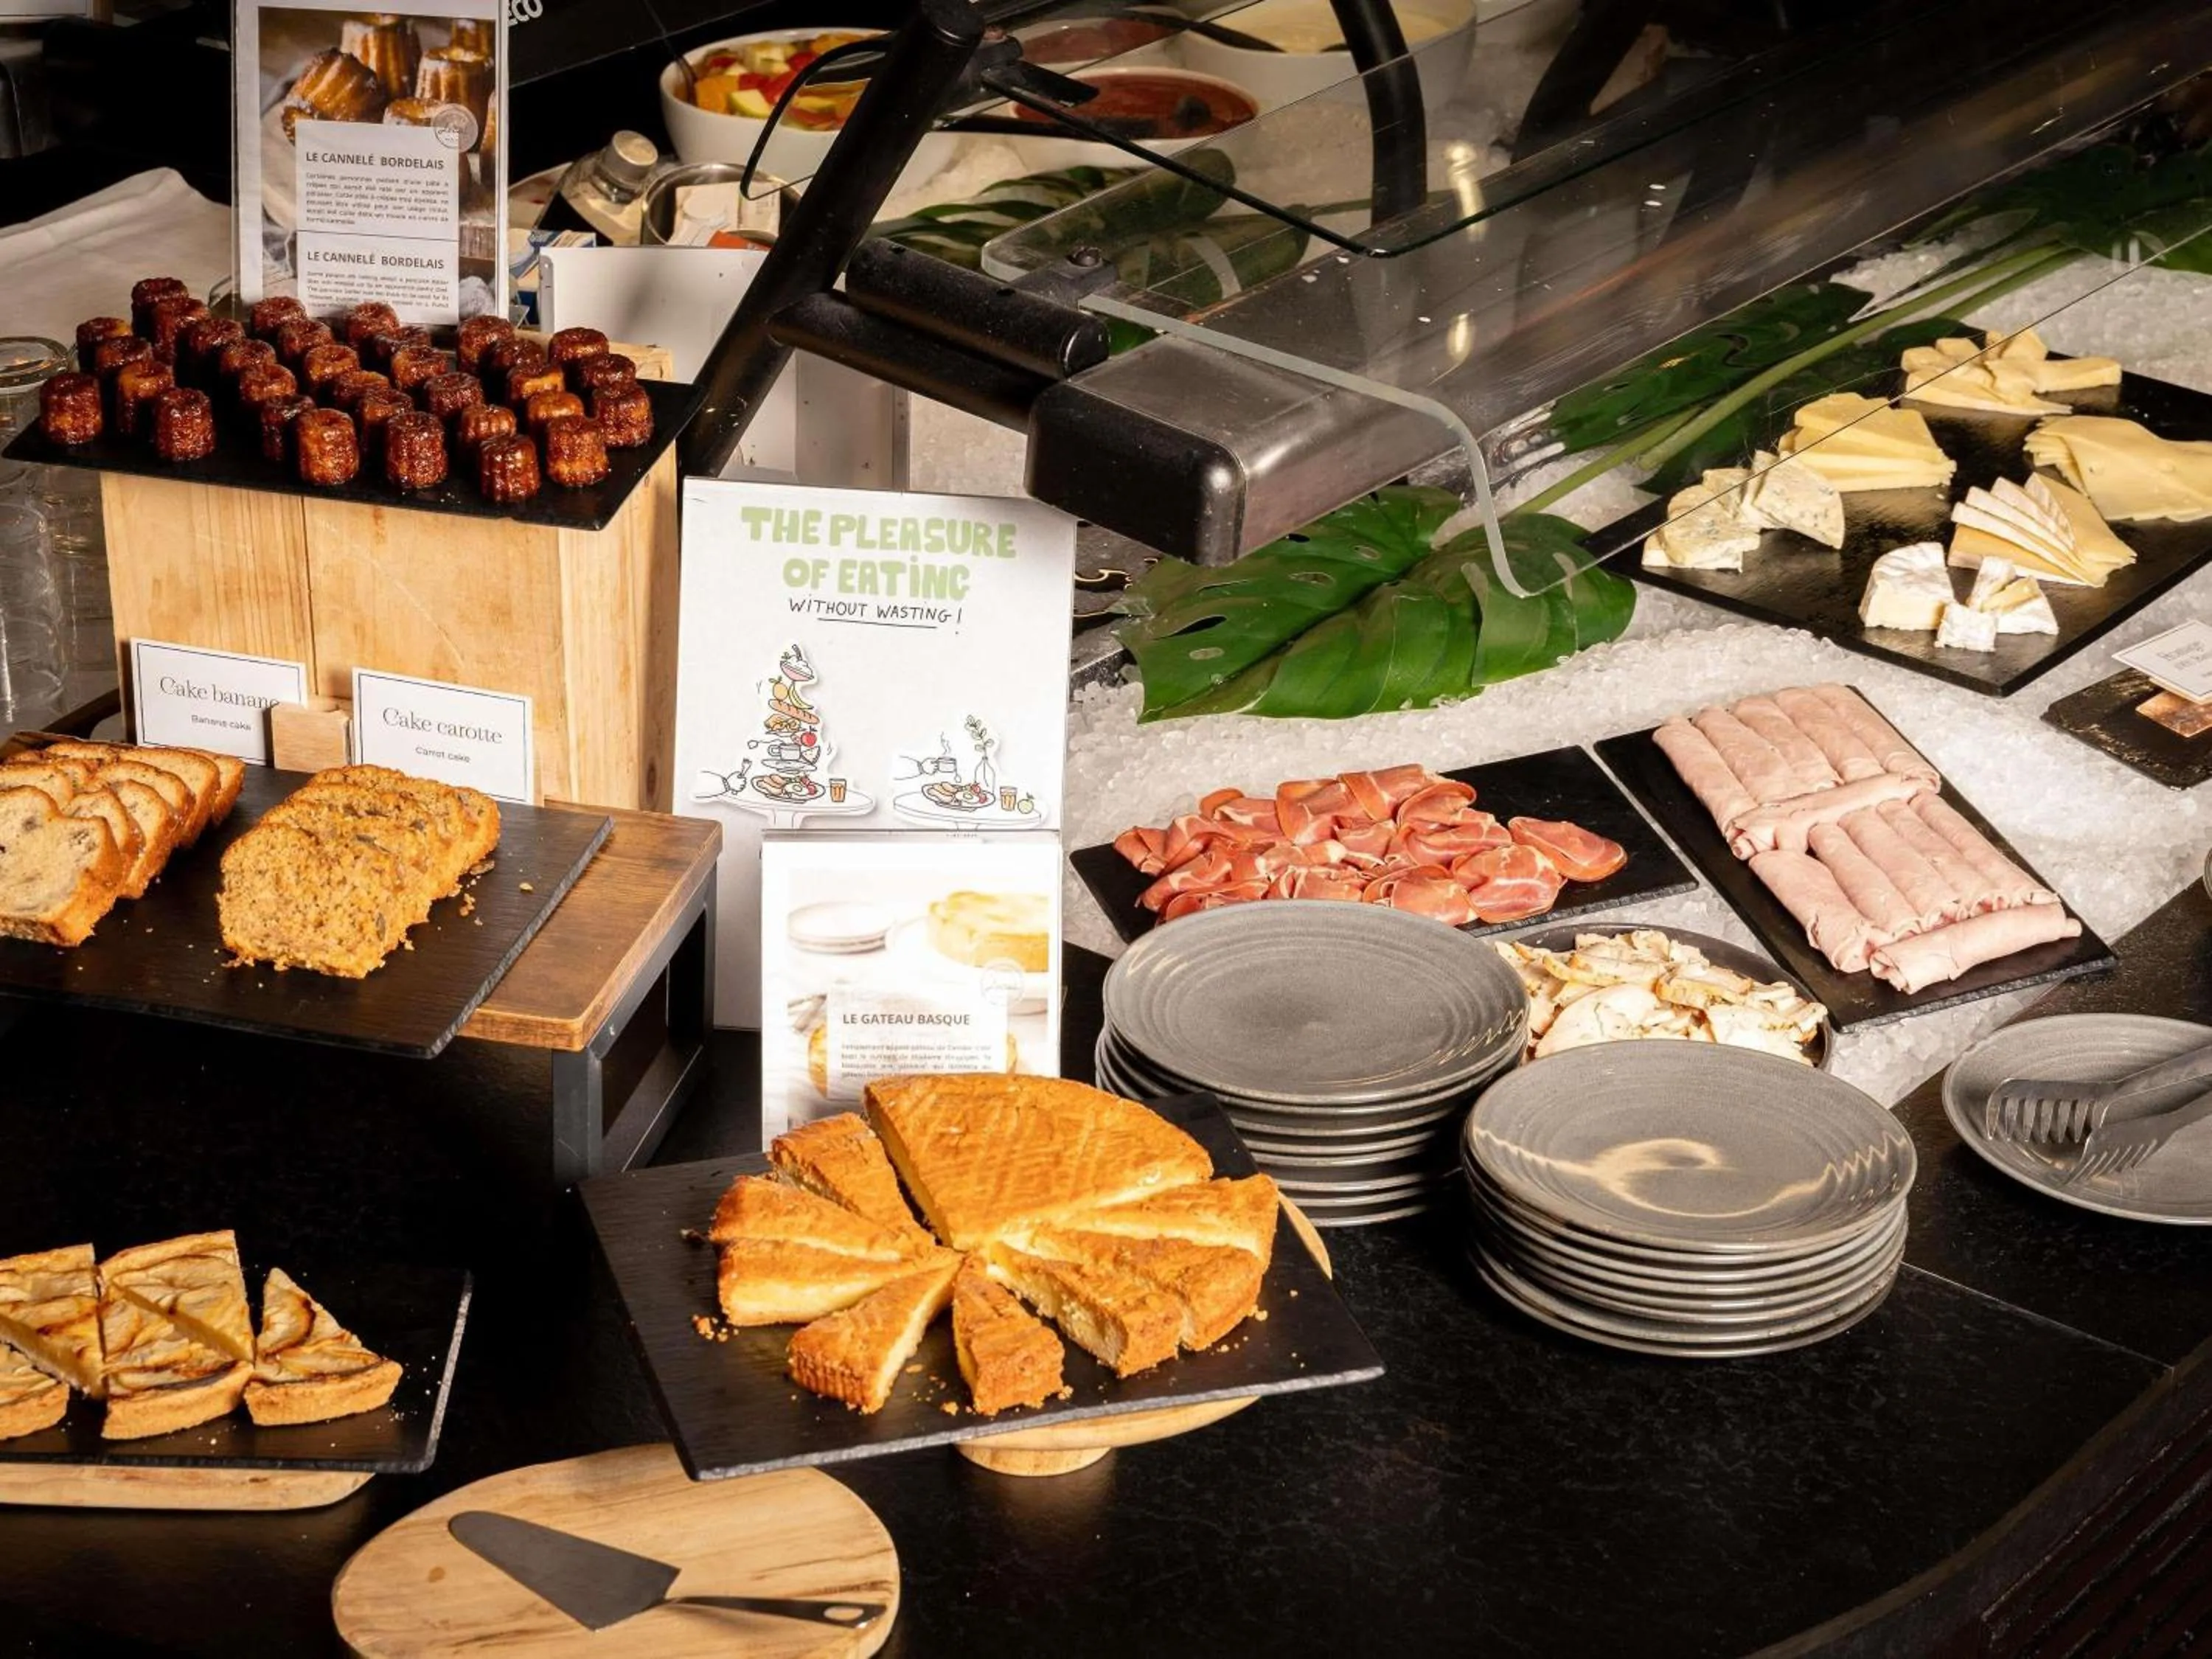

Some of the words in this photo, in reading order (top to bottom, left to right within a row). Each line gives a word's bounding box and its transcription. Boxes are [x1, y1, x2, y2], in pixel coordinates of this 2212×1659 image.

[306, 152, 318, 161] LE
[321, 153, 374, 165] CANNELÉ
[380, 156, 444, 170] BORDELAIS
[307, 251, 319, 261] LE
[381, 256, 444, 269] BORDELAIS
[741, 507, 822, 545] THE
[829, 514, 1017, 559] PLEASURE
[782, 557, 830, 590] OF
[789, 594, 868, 616] WITHOUT
[160, 676, 208, 700] Cake
[212, 684, 280, 709] banane
[383, 707, 431, 732] Cake
[437, 720, 502, 744] carotte
[415, 746, 445, 759] Carrot
[448, 752, 470, 763] cake
[843, 1014, 858, 1024] LE
[861, 1014, 914, 1025] GATEAU
[918, 1014, 970, 1026] BASQUE
